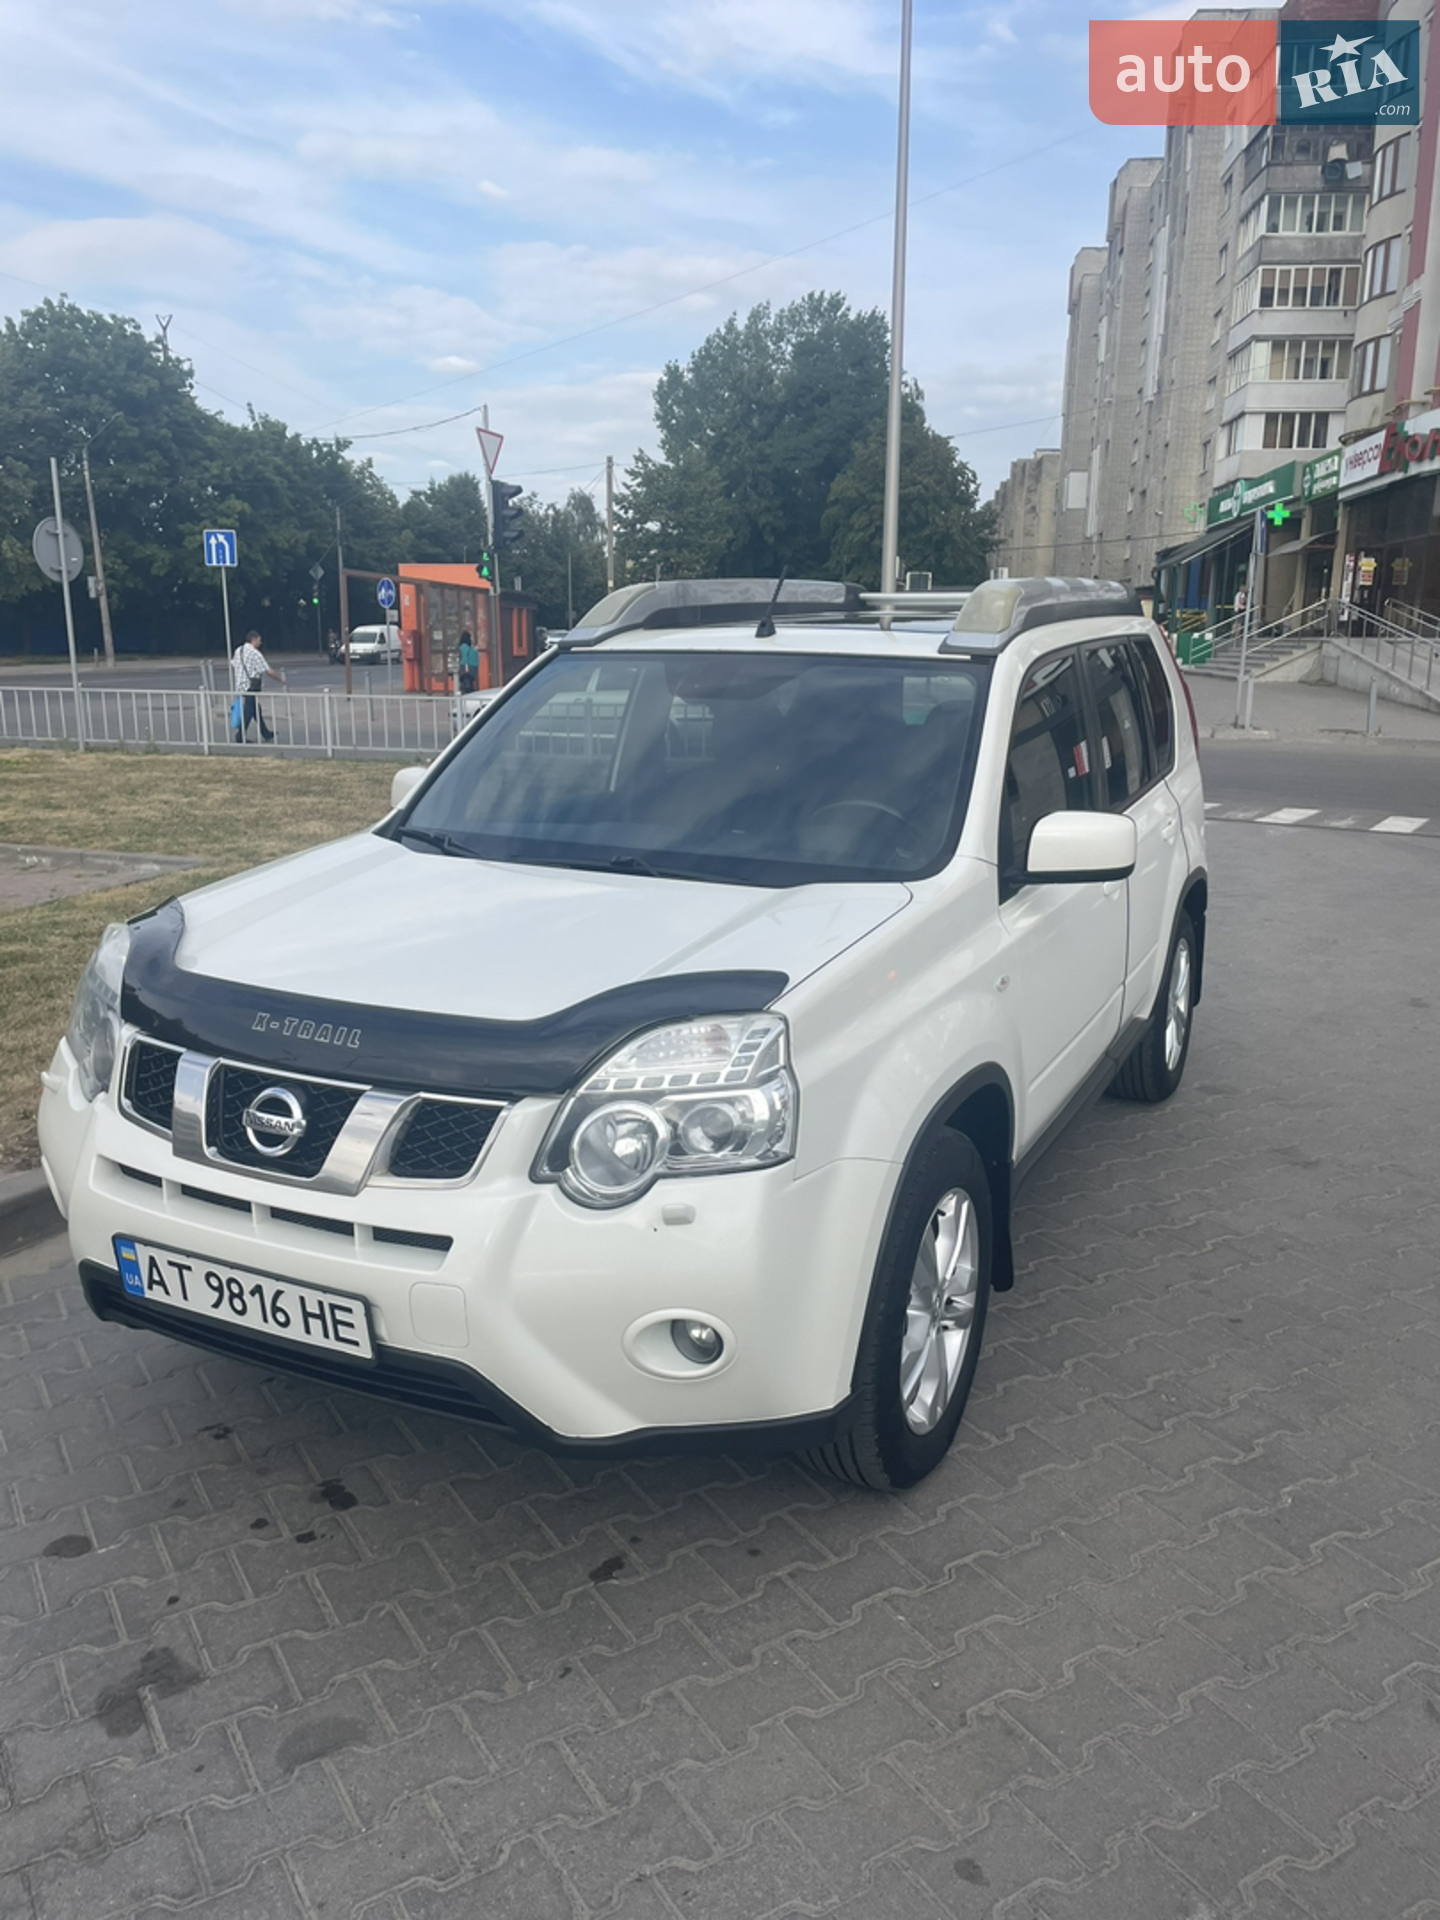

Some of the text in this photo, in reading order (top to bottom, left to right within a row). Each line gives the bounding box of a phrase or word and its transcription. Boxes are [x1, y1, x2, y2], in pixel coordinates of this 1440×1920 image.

[252, 1012, 362, 1048] X-TRAIL
[244, 1110, 295, 1132] NISSAN
[125, 1272, 143, 1287] UA
[147, 1255, 360, 1347] AT 9816 HE
